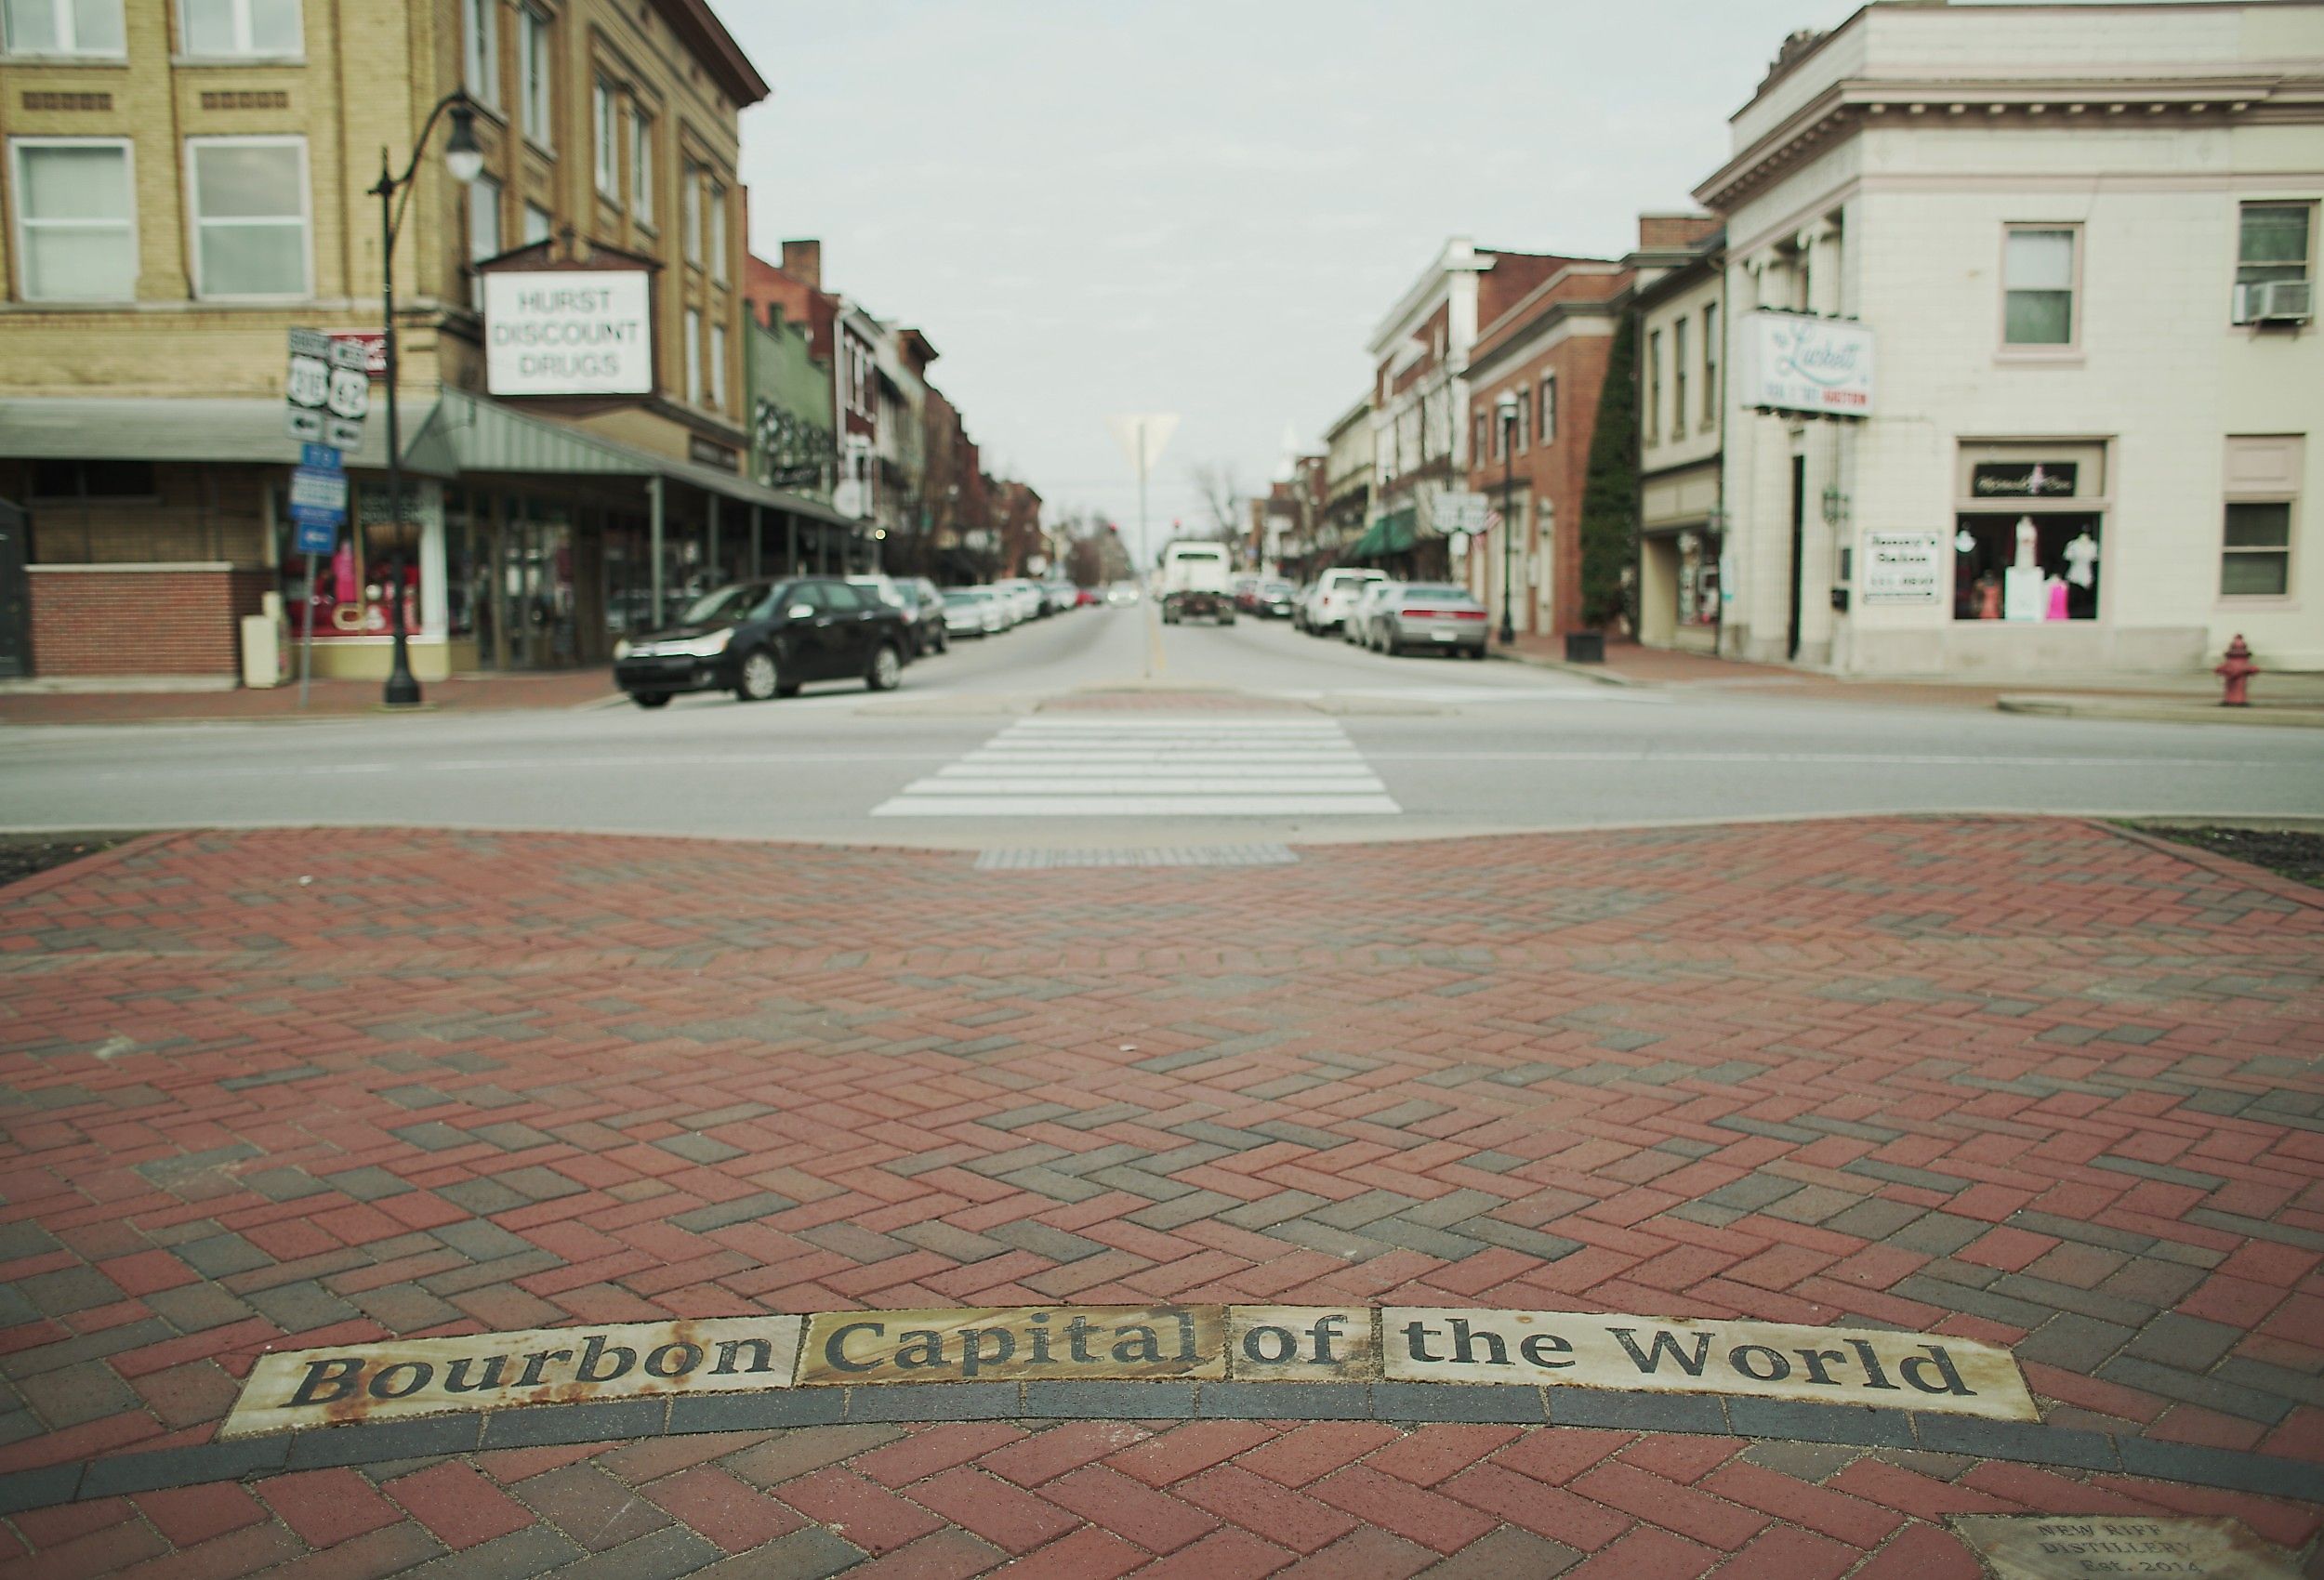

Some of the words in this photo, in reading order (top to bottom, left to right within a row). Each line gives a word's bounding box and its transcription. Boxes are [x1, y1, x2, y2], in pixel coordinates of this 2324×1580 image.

[518, 287, 612, 313] HURST
[493, 320, 636, 347] DISCOUNT
[519, 353, 621, 378] DRUGS
[278, 1334, 776, 1410] Bourbon
[822, 1310, 1214, 1378] Capital
[1242, 1312, 1349, 1364] of
[1400, 1317, 1577, 1368] the
[1604, 1326, 1979, 1398] World
[2038, 1524, 2094, 1536] NEW
[2102, 1524, 2161, 1535] RIFF
[2039, 1542, 2193, 1554] DISTILLERY
[2080, 1560, 2133, 1572] Est.
[2139, 1561, 2203, 1573] 2014
